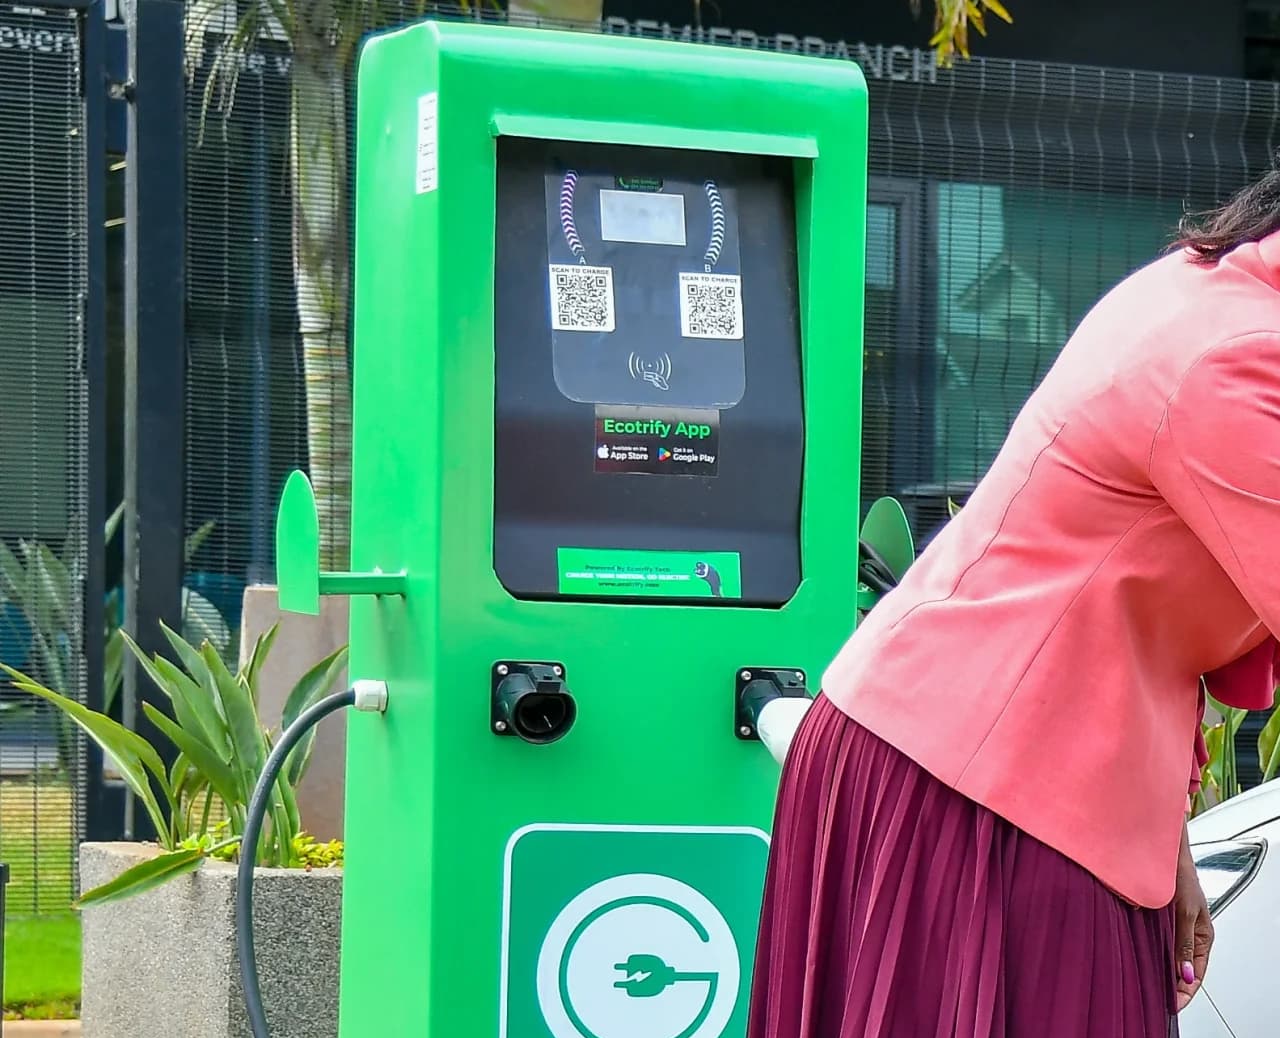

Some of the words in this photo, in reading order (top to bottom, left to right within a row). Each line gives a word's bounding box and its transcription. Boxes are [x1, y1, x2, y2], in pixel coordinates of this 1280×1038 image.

[579, 255, 587, 265] A
[704, 263, 712, 273] B
[603, 419, 671, 437] Ecotrify
[675, 421, 711, 439] App
[610, 452, 627, 461] App
[627, 452, 649, 461] Store
[673, 453, 699, 463] Google
[700, 454, 716, 464] Play
